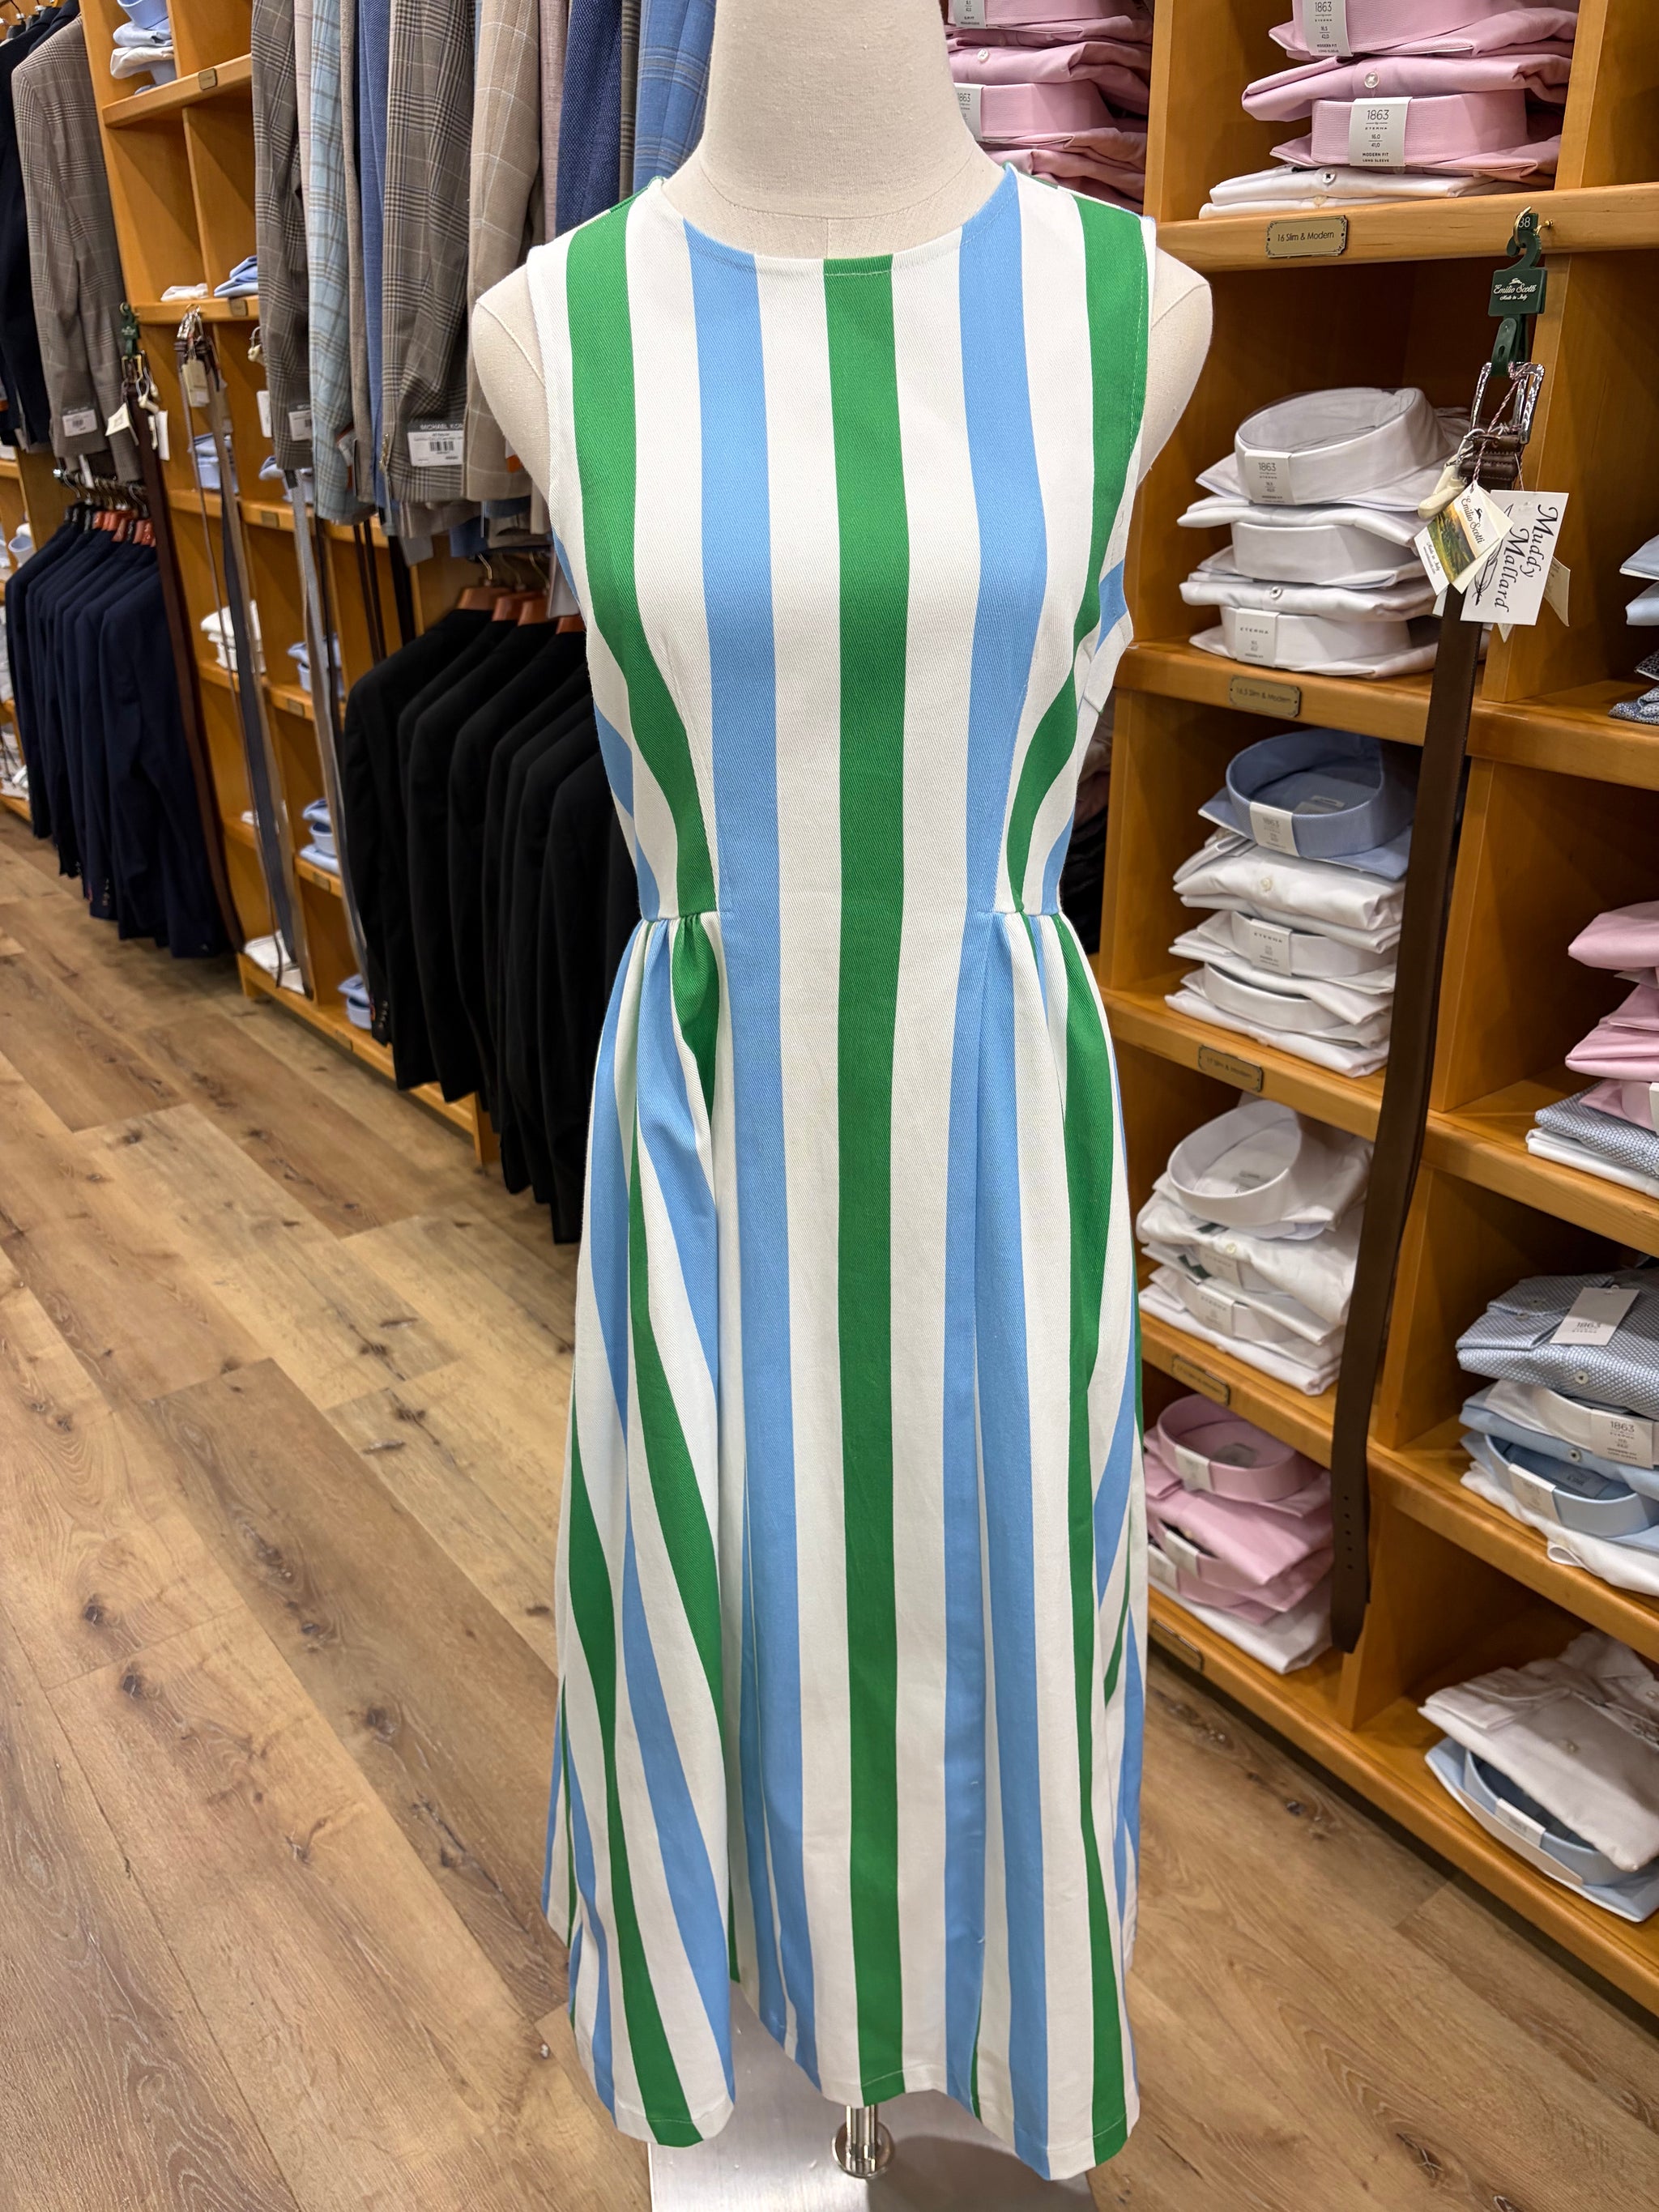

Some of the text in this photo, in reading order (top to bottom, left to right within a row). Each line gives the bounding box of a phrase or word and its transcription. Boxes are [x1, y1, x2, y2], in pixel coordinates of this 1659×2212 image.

[1315, 2, 1333, 12] 1863
[1367, 109, 1390, 121] 1863
[1277, 231, 1334, 242] 16 Slim & Modern
[1494, 283, 1537, 295] Emilio Scotti
[1258, 462, 1277, 472] 1863
[1461, 495, 1486, 544] Emilio Scotti
[1520, 504, 1559, 578] Muddy
[1495, 527, 1529, 613] Mallard
[1610, 1421, 1636, 1433] 1863
